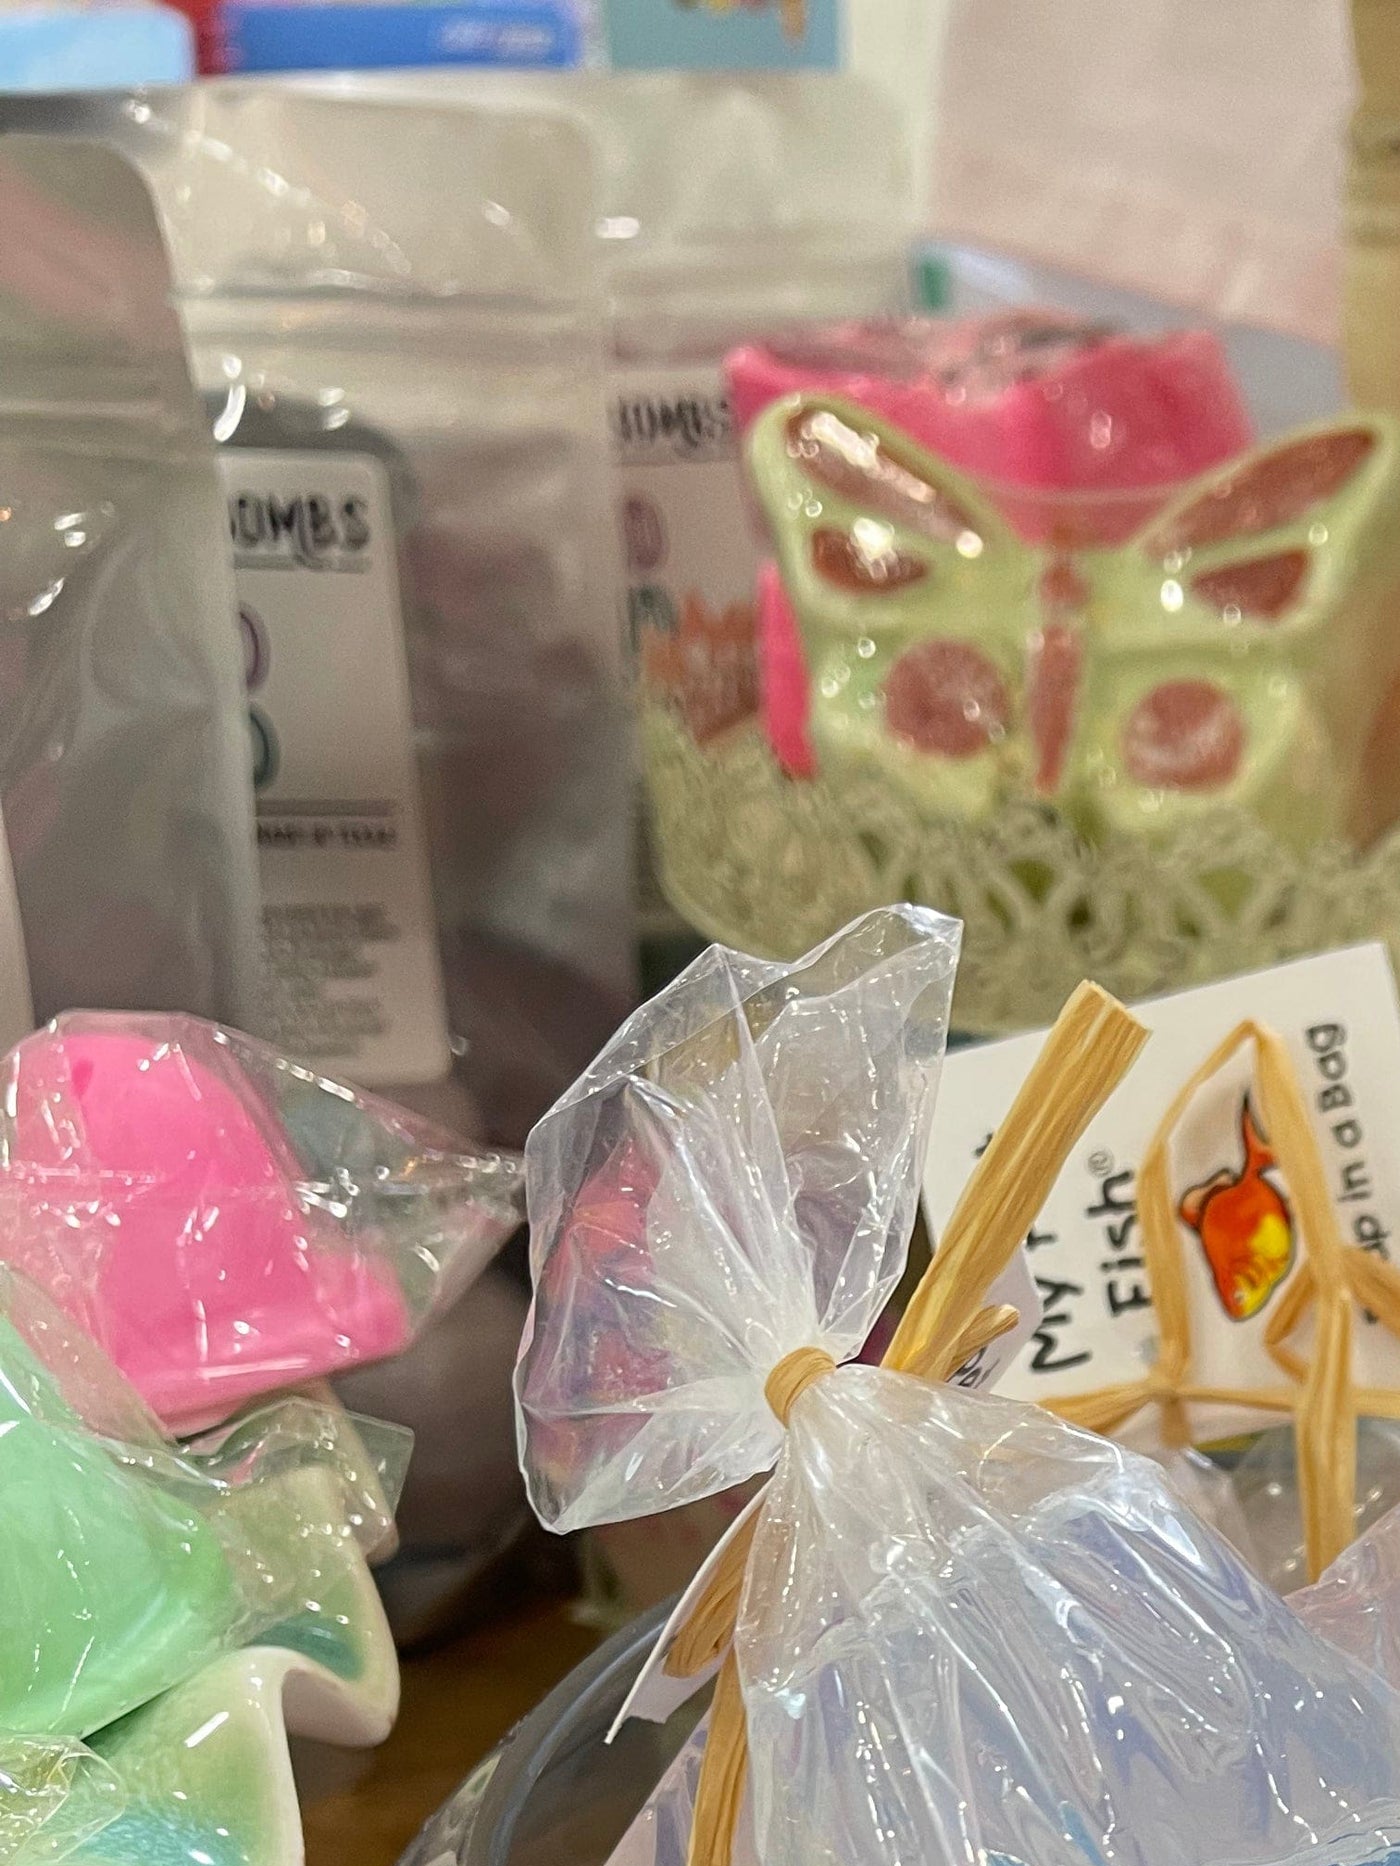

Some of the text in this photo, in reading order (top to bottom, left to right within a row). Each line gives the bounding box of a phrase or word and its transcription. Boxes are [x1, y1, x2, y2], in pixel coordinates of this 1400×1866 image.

[230, 493, 371, 562] OMBS
[1305, 1022, 1352, 1114] Bag
[1331, 1120, 1362, 1148] a
[1339, 1160, 1372, 1203] In
